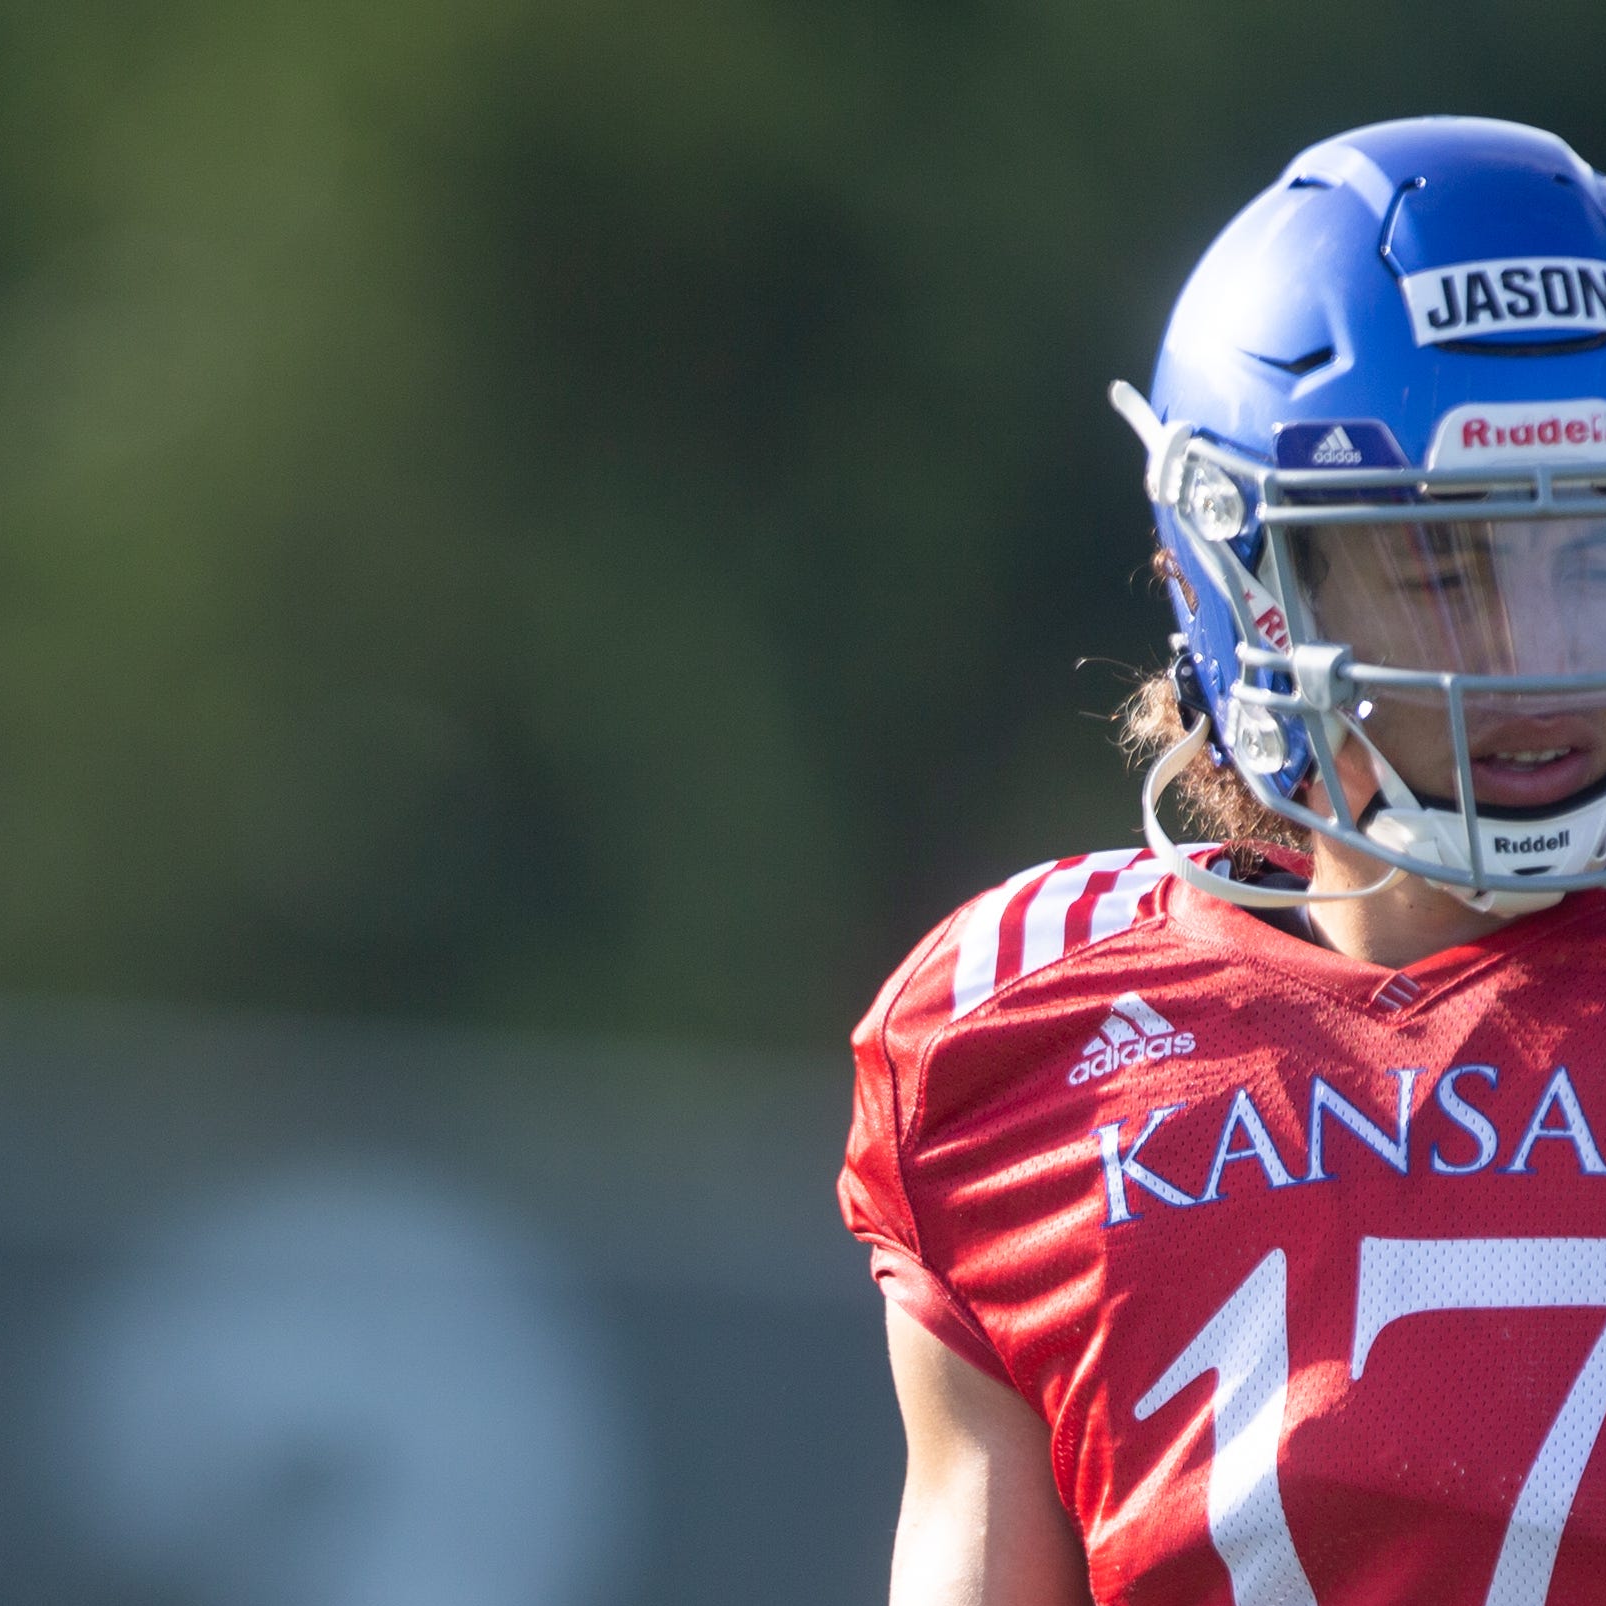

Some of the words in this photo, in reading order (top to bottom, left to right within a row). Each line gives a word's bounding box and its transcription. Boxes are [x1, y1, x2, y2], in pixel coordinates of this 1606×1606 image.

[1313, 449, 1363, 465] adidas
[1494, 829, 1571, 854] Riddell
[1067, 1031, 1197, 1086] adidas
